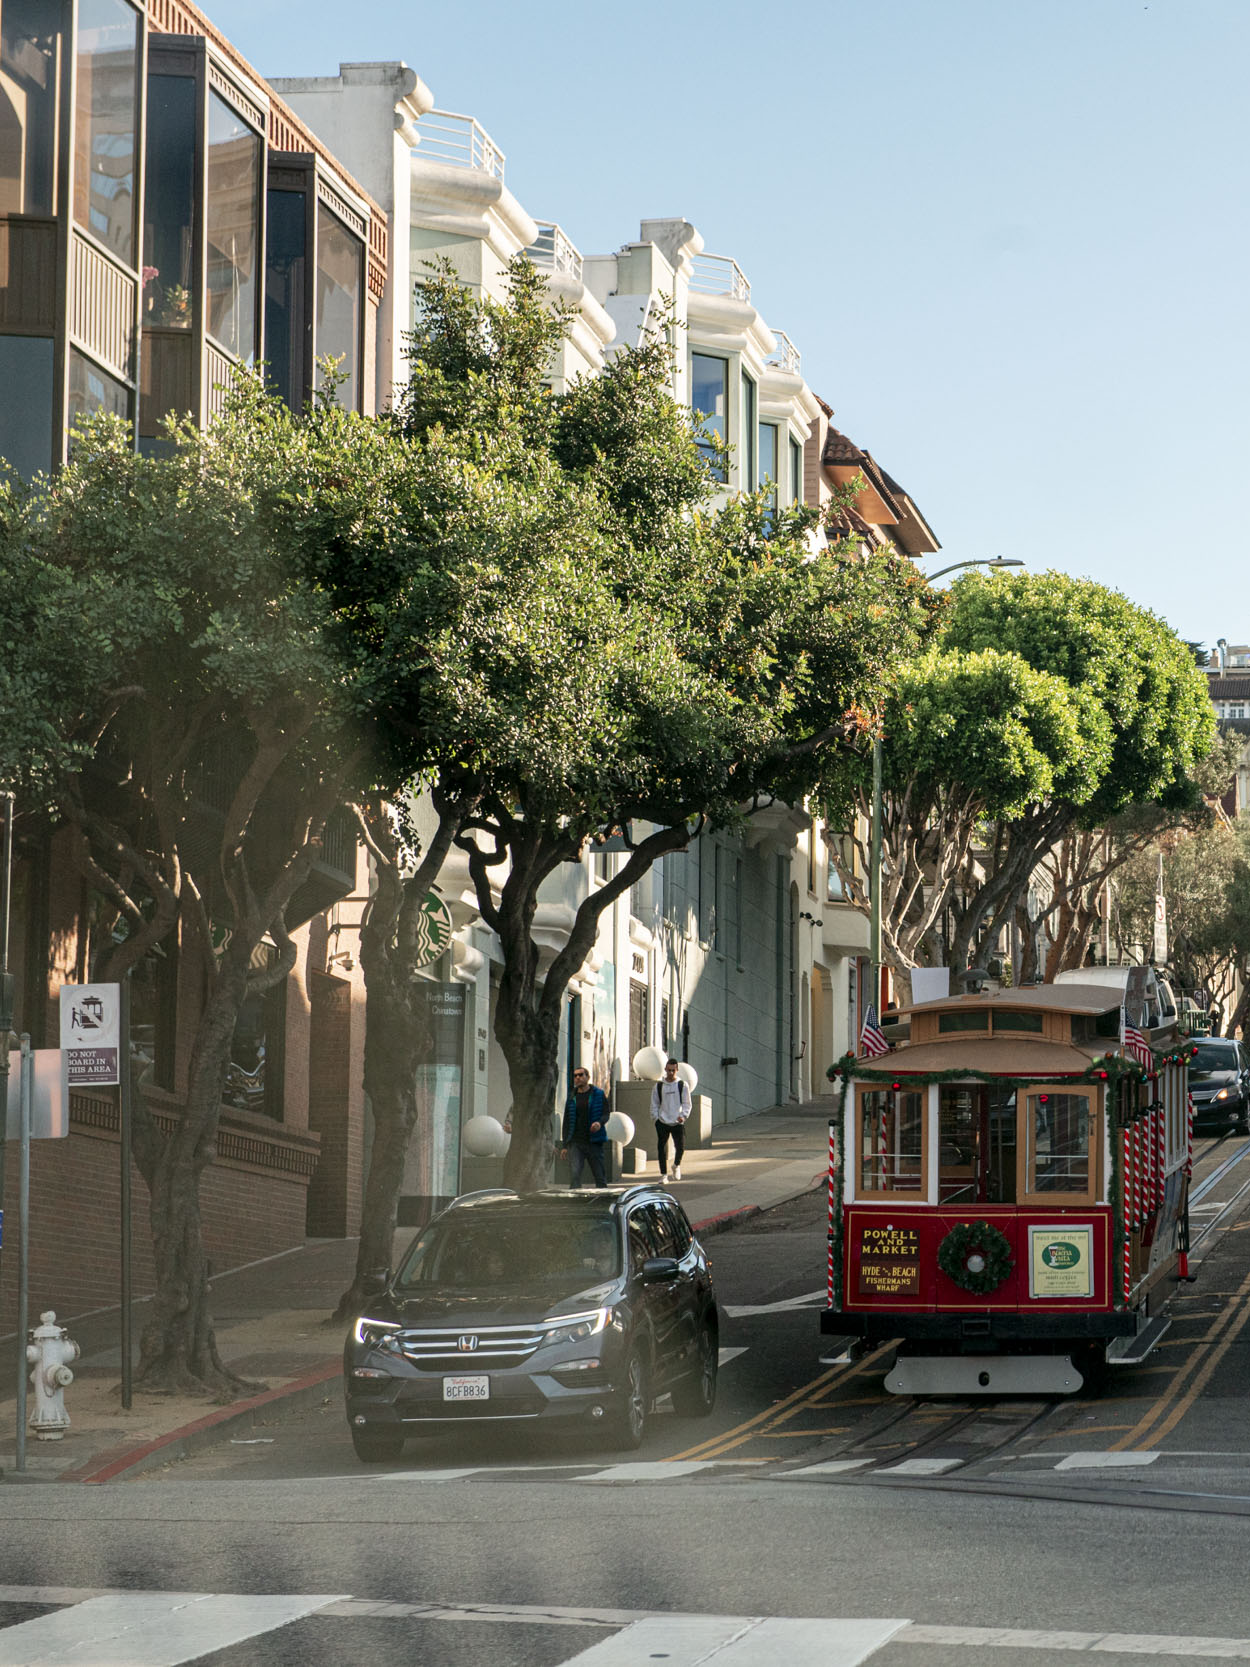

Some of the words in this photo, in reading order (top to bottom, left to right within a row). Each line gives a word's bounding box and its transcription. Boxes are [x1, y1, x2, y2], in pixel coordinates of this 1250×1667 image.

[444, 992, 463, 1002] Beach
[88, 1065, 111, 1073] AREA
[863, 1230, 918, 1240] POWELL
[862, 1245, 918, 1255] MARKET
[862, 1265, 881, 1276] HYDE
[892, 1266, 917, 1277] BEACH
[865, 1276, 911, 1286] FISHERMANS
[876, 1284, 900, 1292] WHARF
[446, 1385, 486, 1397] 8CFB836
